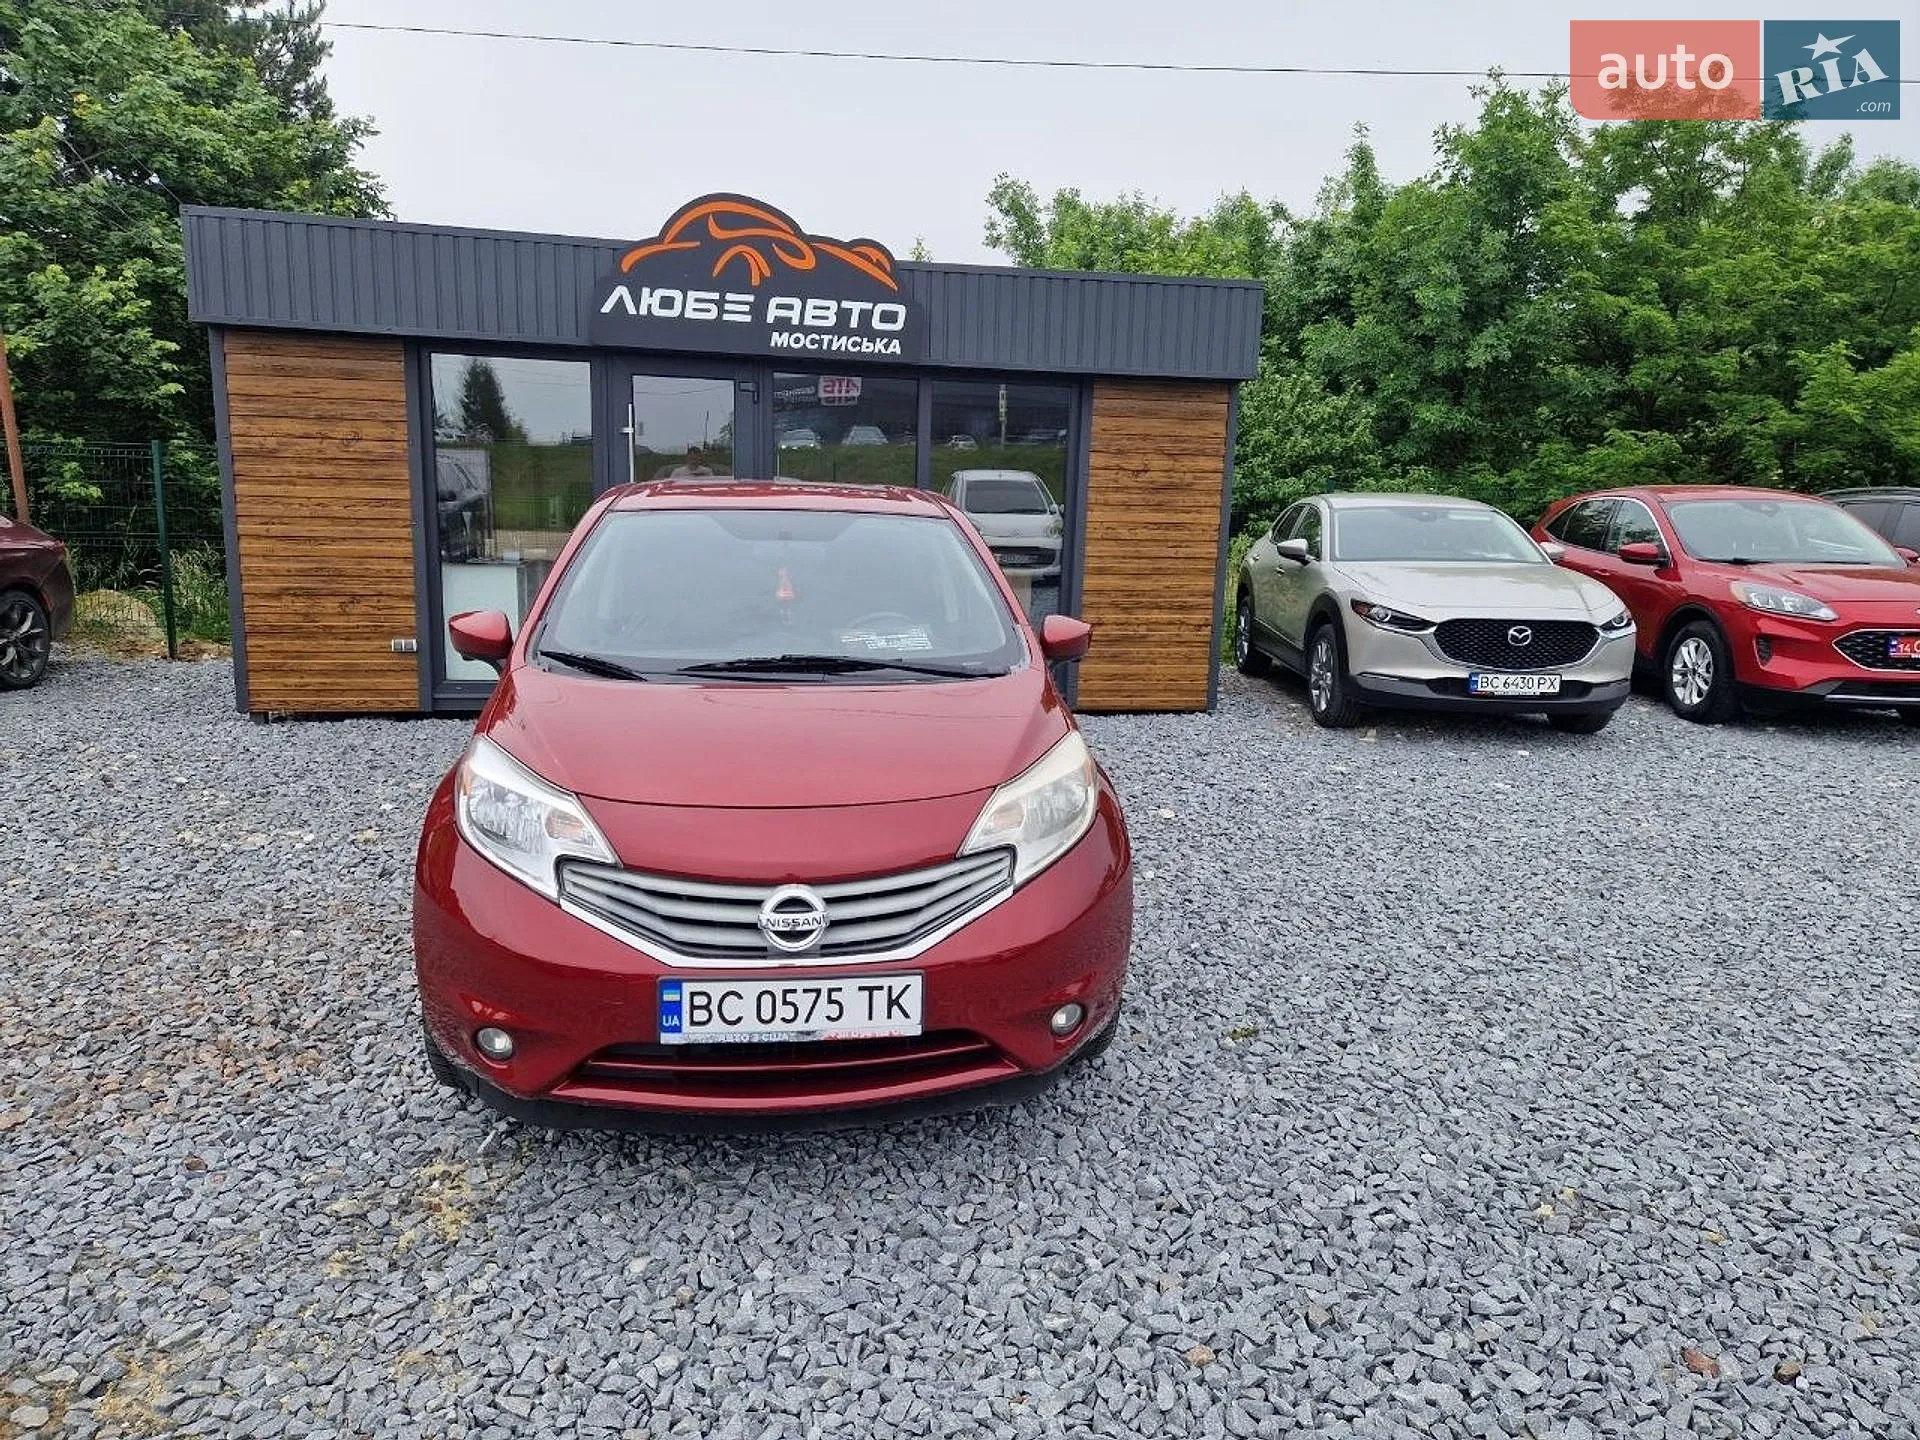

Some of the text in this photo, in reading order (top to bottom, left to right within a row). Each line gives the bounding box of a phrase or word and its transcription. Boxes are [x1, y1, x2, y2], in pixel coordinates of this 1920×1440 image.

[600, 285, 907, 331] ЛЮБЕ АВТО
[770, 332, 901, 355] МОСТИСЬКА
[1480, 676, 1557, 690] BC 6430 PX
[767, 916, 822, 928] NISSAN
[688, 984, 912, 1027] BC 0575 TK
[662, 1016, 680, 1027] UA
